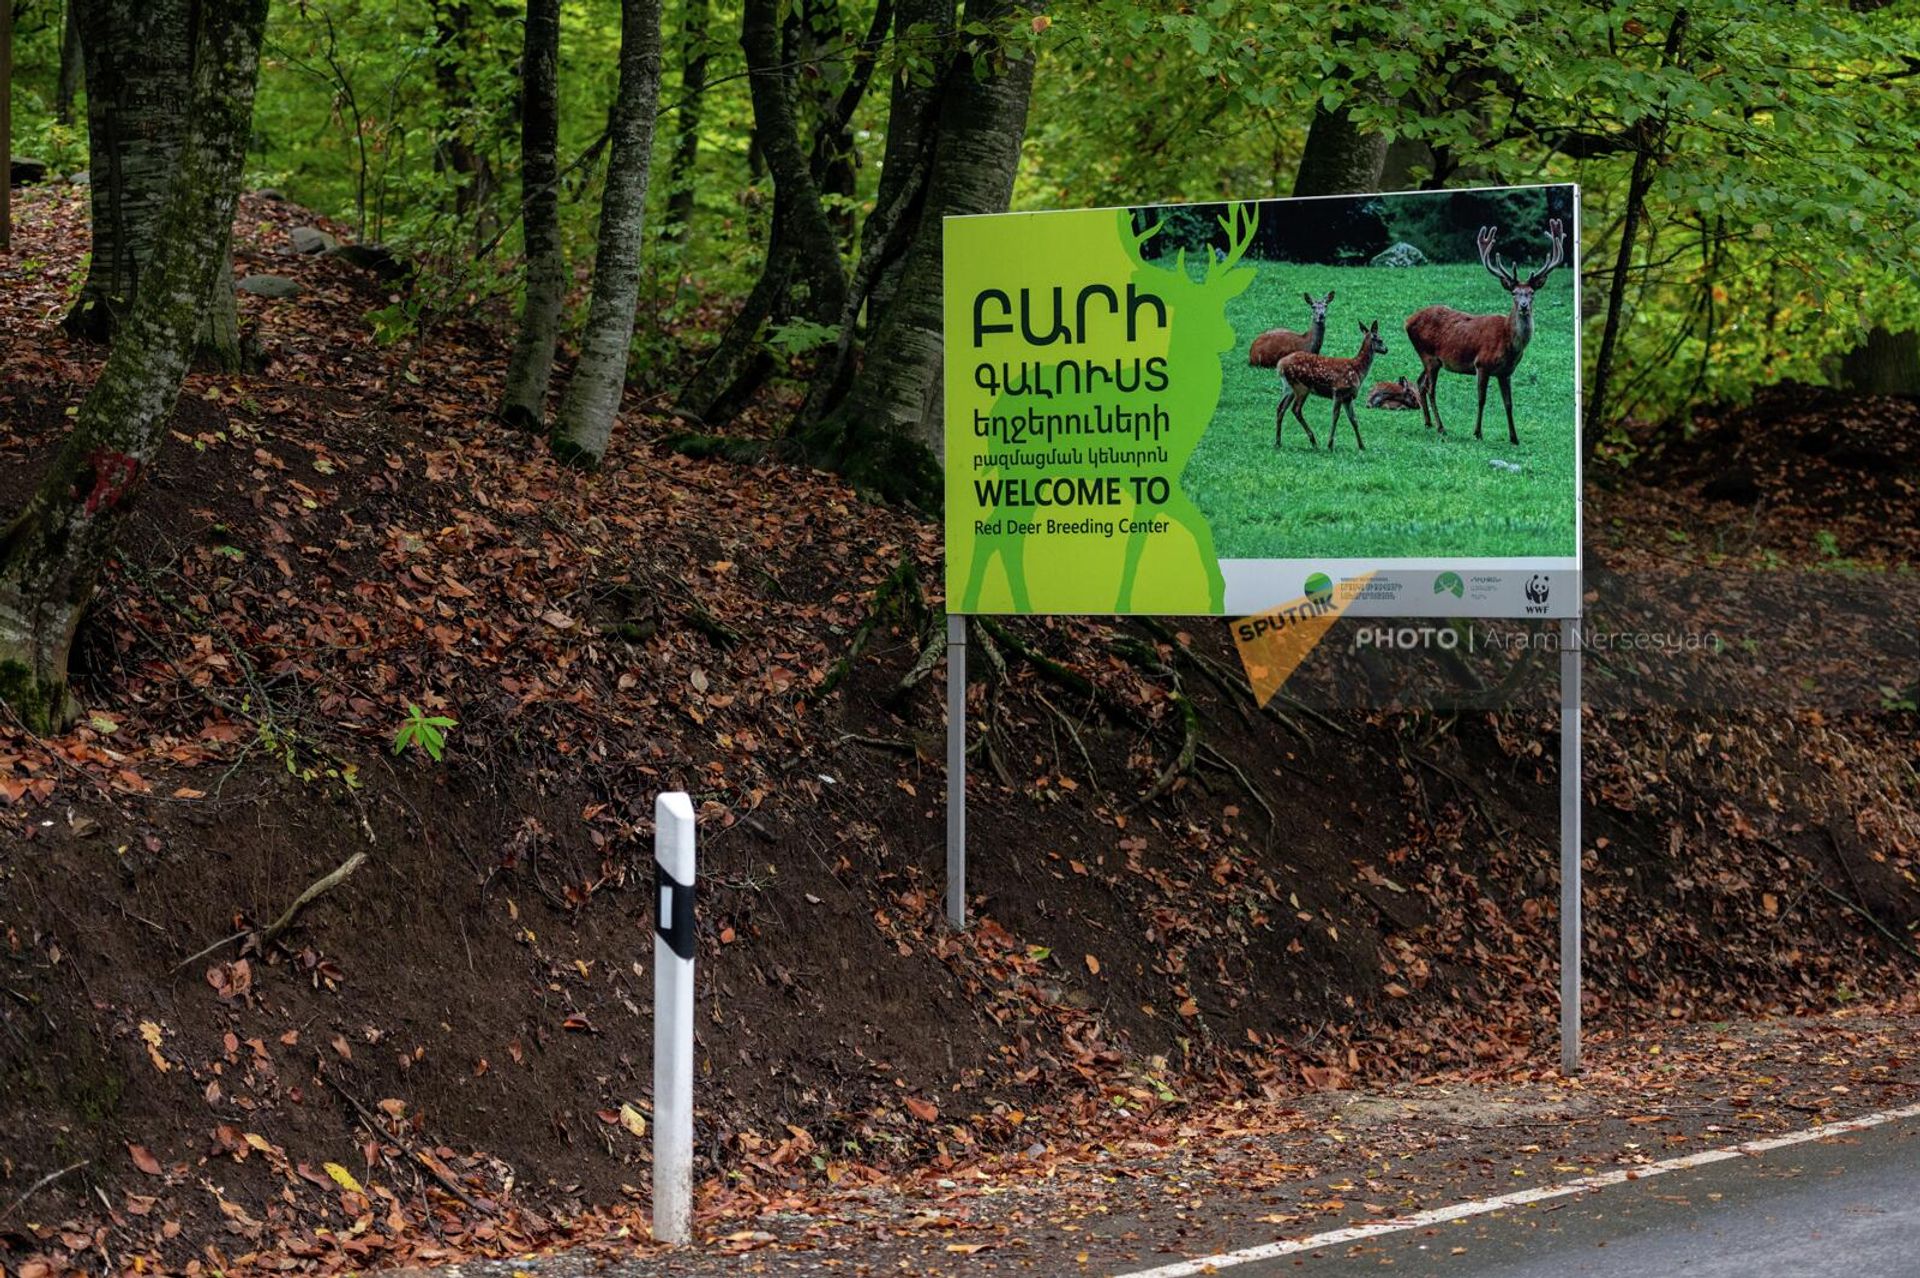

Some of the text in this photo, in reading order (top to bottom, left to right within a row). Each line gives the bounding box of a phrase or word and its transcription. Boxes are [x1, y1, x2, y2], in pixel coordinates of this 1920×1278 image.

[973, 283, 1167, 348] ԲԱՐԻ
[974, 357, 1169, 399] ԳԱԼՈՒՍՏ
[974, 403, 1170, 444] եղջերուների
[973, 446, 1168, 470] բազմացման կենտրոն
[974, 476, 1171, 507] WELCOME TO
[974, 518, 1170, 538] Red Deer Breeding Center
[1525, 606, 1550, 614] WWF
